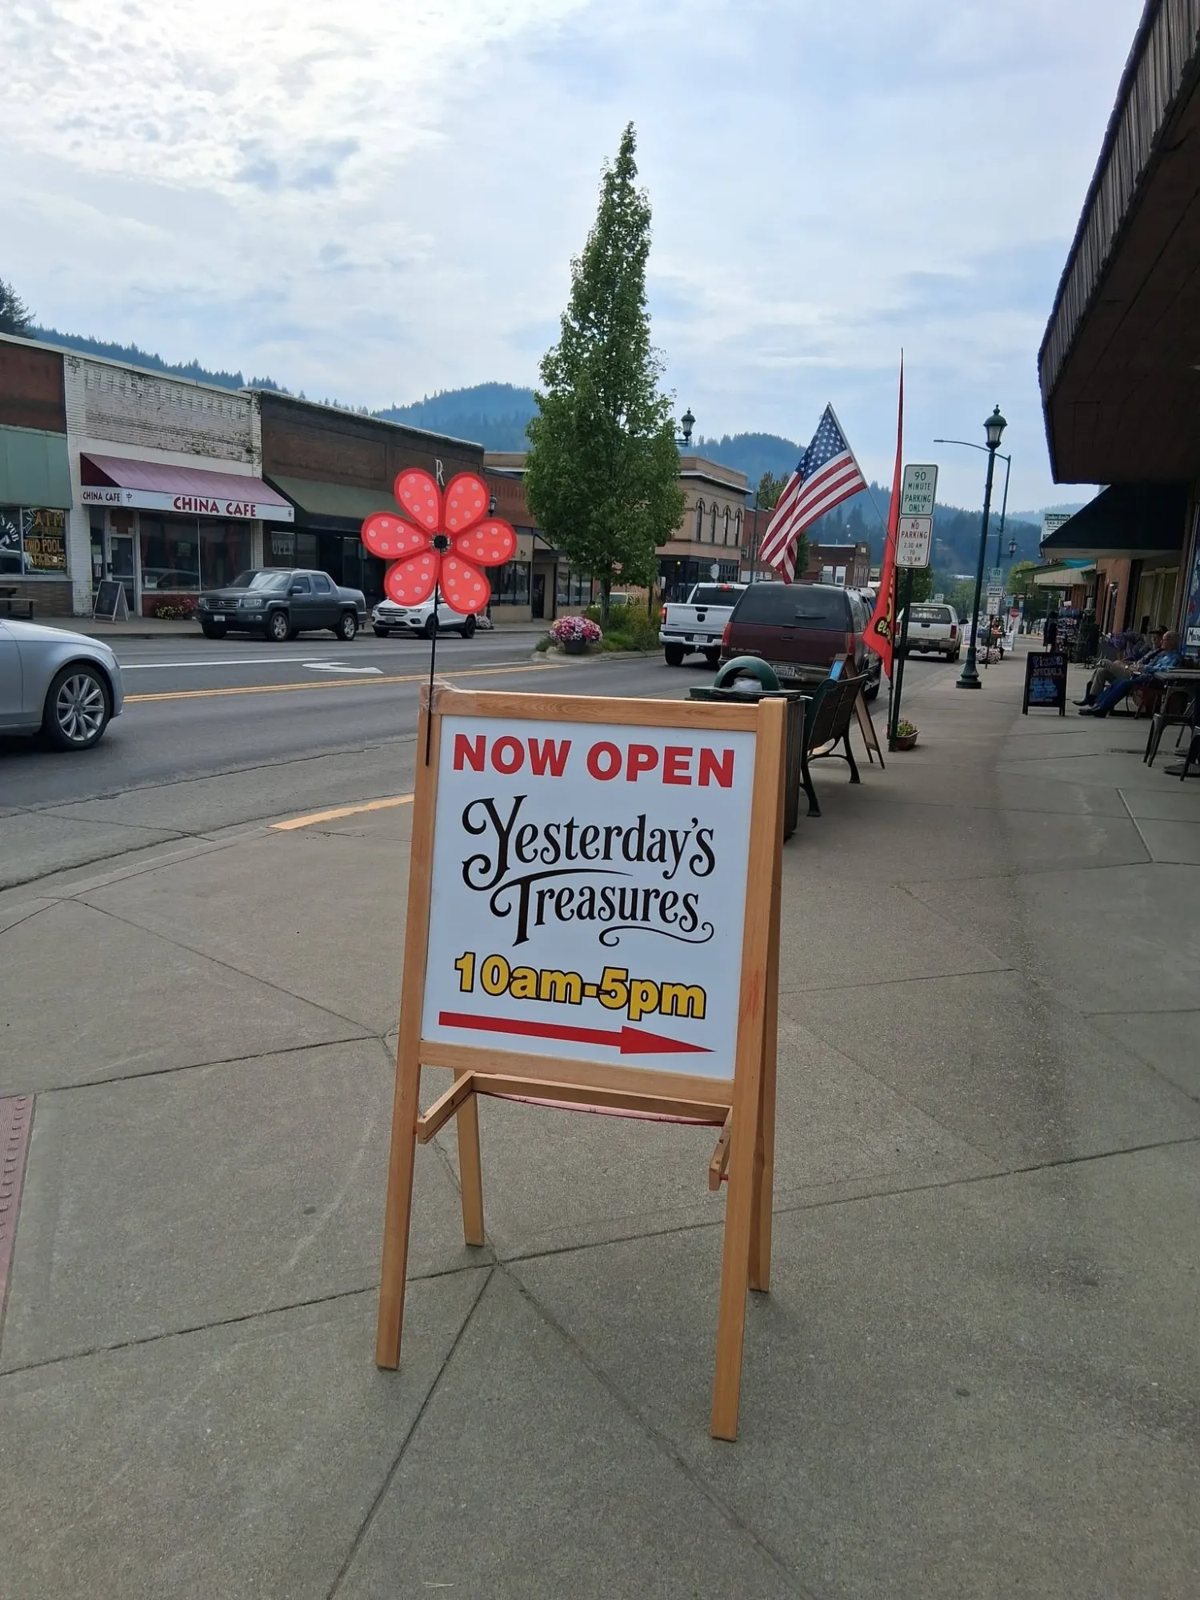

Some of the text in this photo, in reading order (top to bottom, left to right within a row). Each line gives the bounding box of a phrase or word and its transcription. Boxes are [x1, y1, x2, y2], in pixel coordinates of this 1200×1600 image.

[914, 471, 927, 481] 90
[908, 482, 931, 491] MINUTE
[83, 491, 120, 502] CHINA CAFE
[905, 494, 931, 503] PARKING
[173, 496, 256, 517] CHINA CAFE
[908, 504, 926, 513] ONLY
[6, 521, 20, 542] PUB
[911, 521, 920, 530] NO
[901, 530, 928, 539] PARKING
[42, 539, 64, 553] POOL
[453, 733, 735, 788] NOW OPEN
[461, 794, 716, 891] Yesterday's
[490, 868, 715, 947] Treasures
[454, 952, 707, 1021] 10am-5pm
